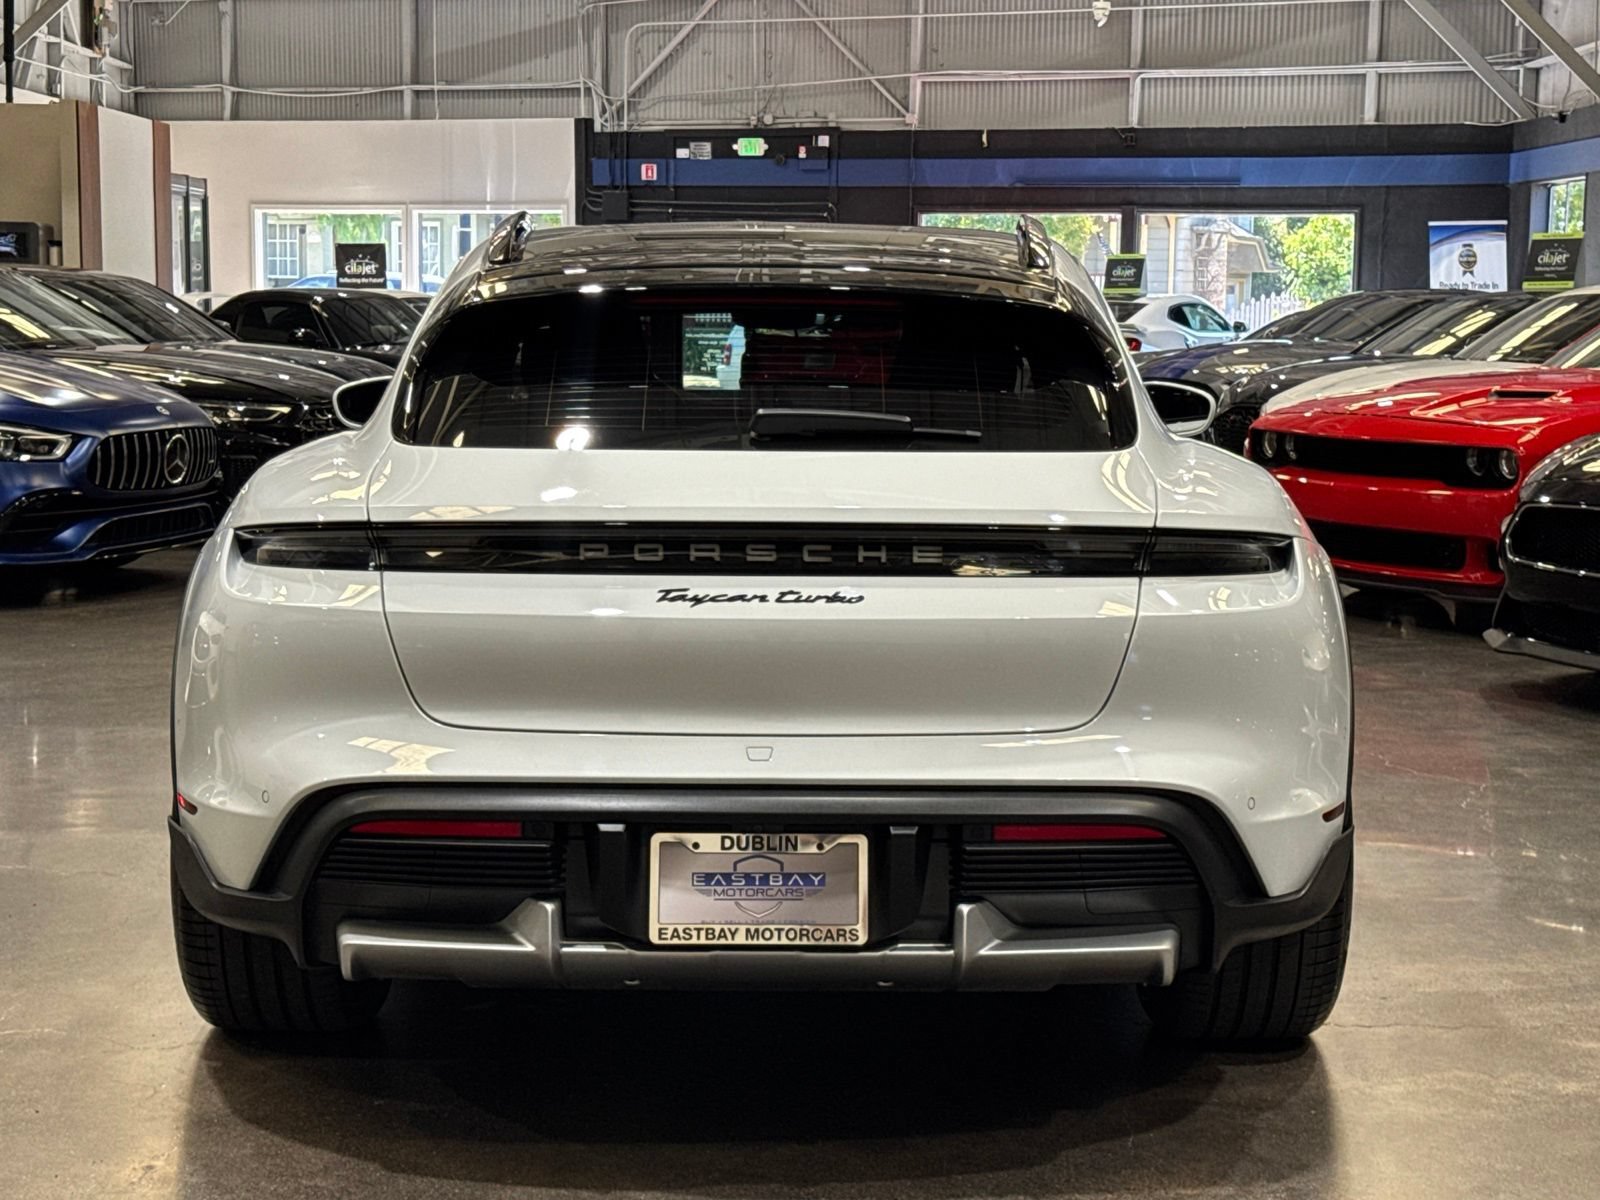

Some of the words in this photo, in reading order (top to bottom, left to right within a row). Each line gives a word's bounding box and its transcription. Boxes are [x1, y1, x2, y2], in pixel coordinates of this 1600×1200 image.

[345, 261, 376, 275] cilajet
[1470, 281, 1490, 289] Trade
[579, 543, 943, 563] PORSCHE
[656, 588, 769, 607] Taycan
[775, 590, 865, 604] turbo
[720, 835, 798, 851] DUBLIN
[693, 873, 825, 886] EASTBAY
[713, 888, 804, 897] MOTORCARS
[658, 927, 739, 941] EASTBAY
[745, 927, 859, 942] MOTORCARS
